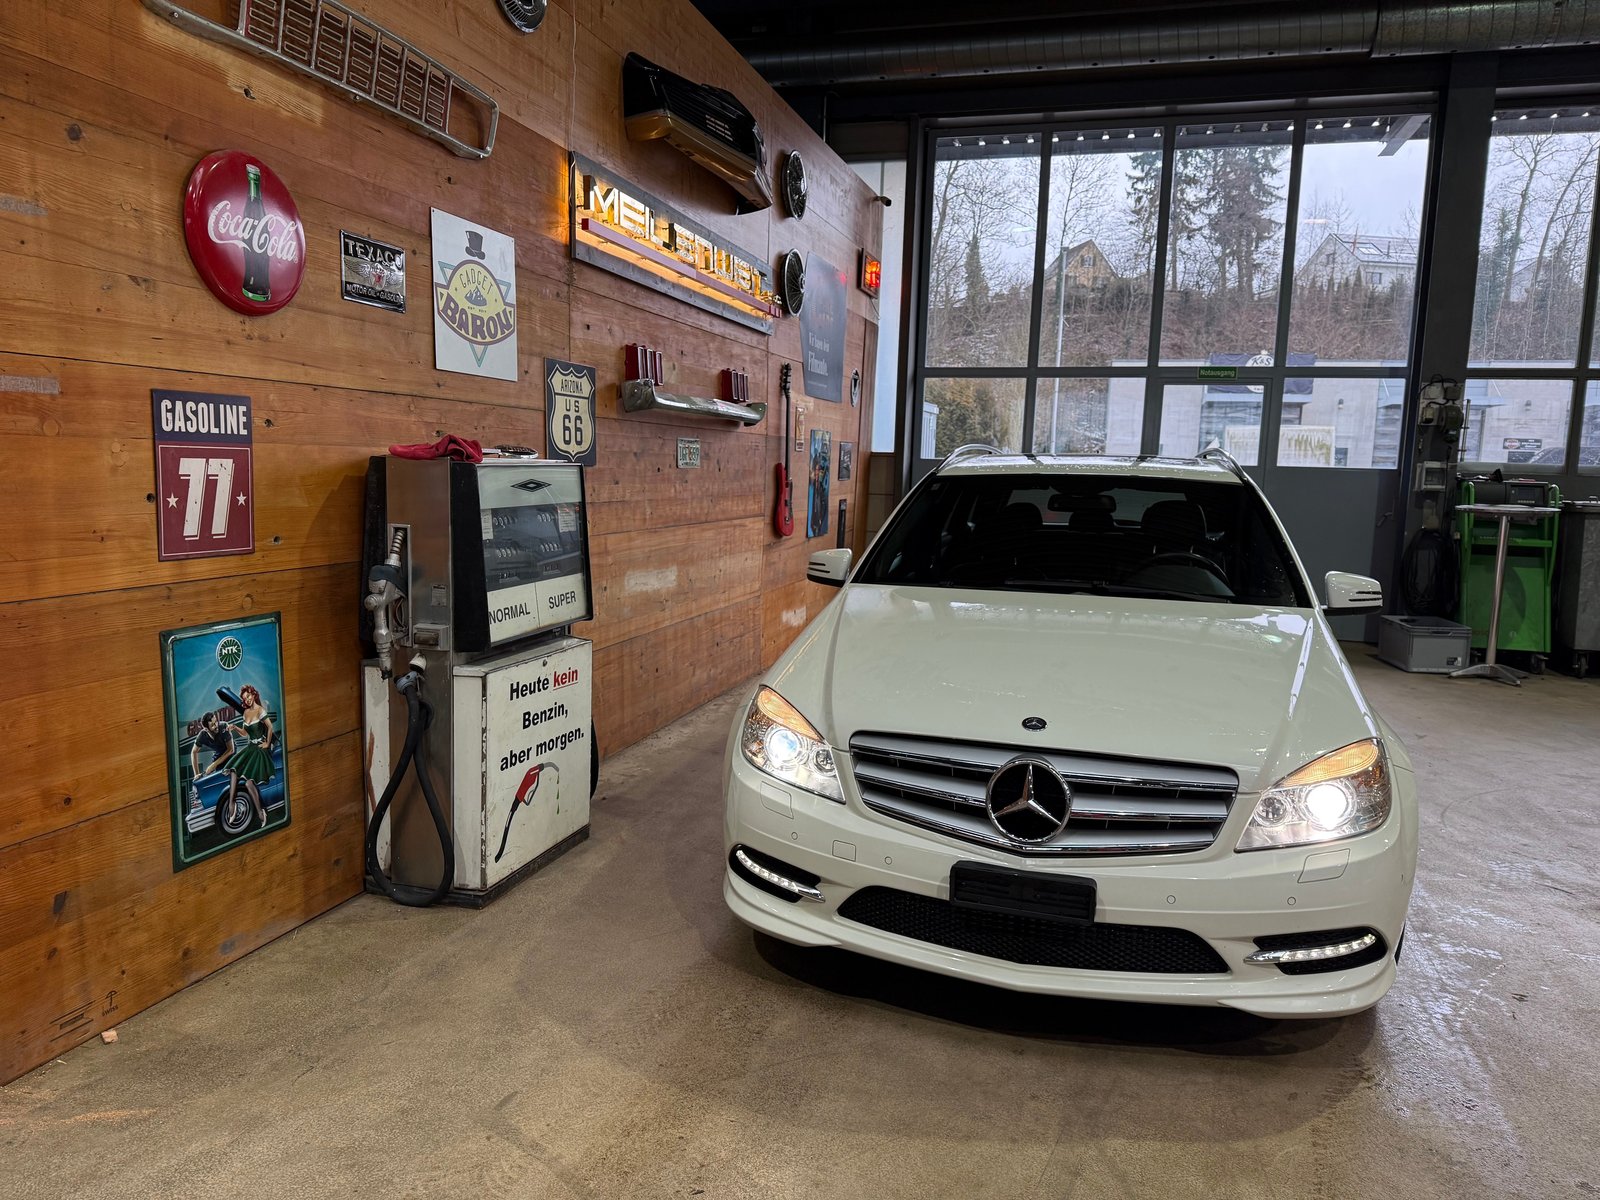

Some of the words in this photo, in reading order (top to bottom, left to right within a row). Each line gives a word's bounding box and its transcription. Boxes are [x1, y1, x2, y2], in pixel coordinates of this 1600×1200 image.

[208, 200, 296, 262] Coca-Cola
[344, 238, 404, 270] TEXACO
[346, 283, 367, 295] MOTOR
[367, 288, 377, 297] OIL
[379, 291, 404, 303] GASOLINE
[459, 268, 494, 295] GADGET
[441, 292, 513, 340] BARON
[1200, 369, 1235, 378] Notausgang
[1251, 356, 1272, 366] K&S
[560, 378, 583, 395] ARIZONA
[160, 398, 248, 436] GASOLINE
[562, 413, 583, 446] 66
[488, 602, 531, 625] NORMAL
[548, 590, 577, 610] SUPER
[221, 645, 238, 656] NTK
[509, 676, 550, 701] Heute
[553, 667, 579, 689] kein
[522, 702, 569, 730] Benzin,
[500, 746, 532, 772] aber
[536, 726, 585, 757] morgen.
